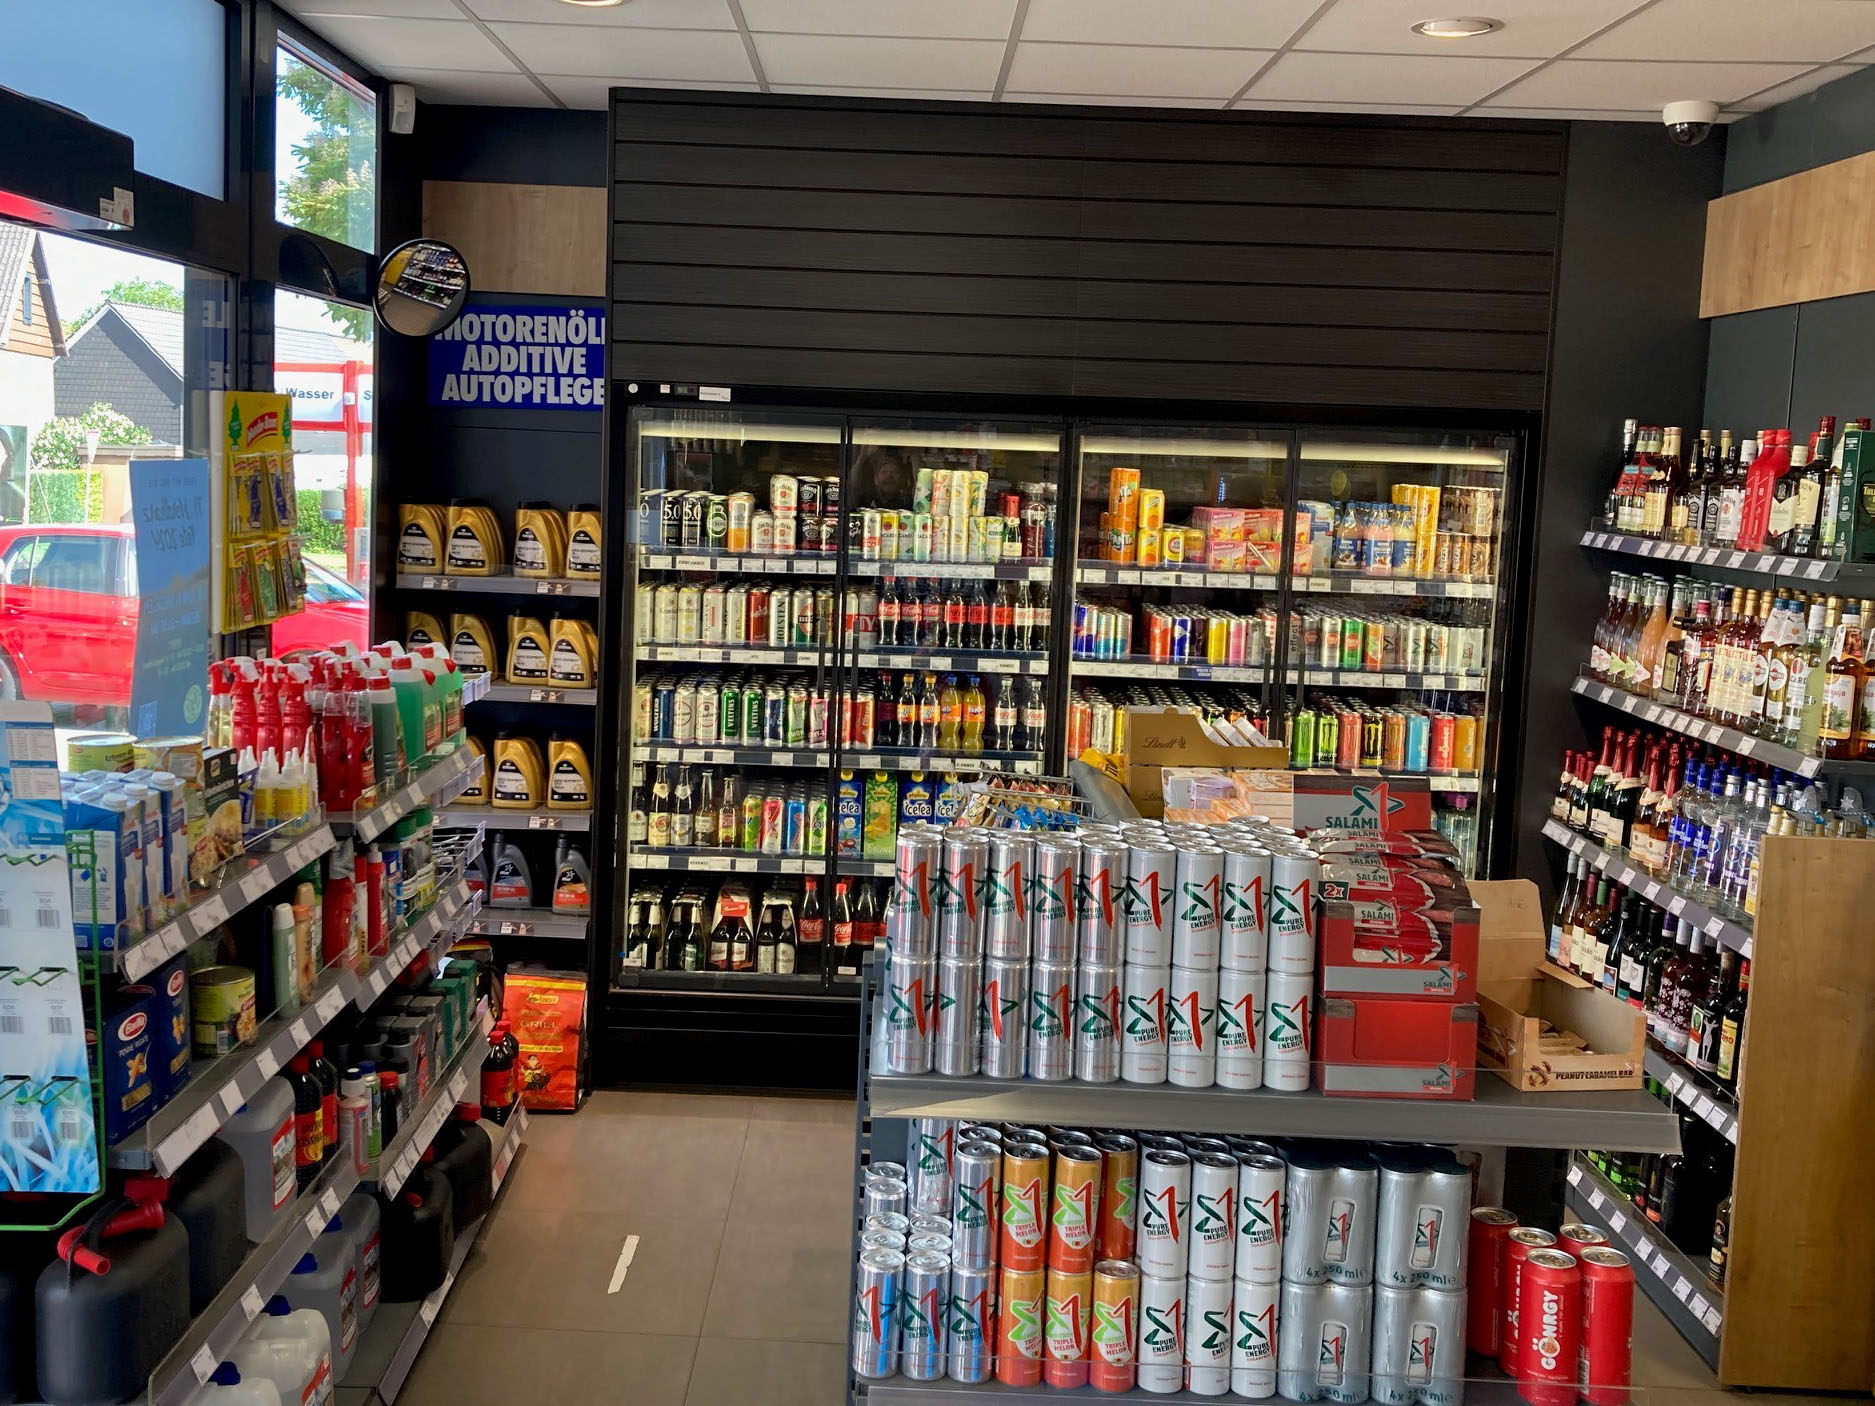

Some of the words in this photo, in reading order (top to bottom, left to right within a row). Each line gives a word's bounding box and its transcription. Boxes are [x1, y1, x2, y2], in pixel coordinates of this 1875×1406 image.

[435, 309, 605, 345] MOTORENÖL
[461, 344, 587, 374] ADDITIVE
[286, 387, 335, 400] Wasser
[441, 373, 605, 405] AUTOPFLEGE
[777, 601, 786, 641] HOLSTEN
[1290, 623, 1299, 652] effect
[727, 699, 735, 728] VELTINS
[750, 699, 759, 729] VELTINS
[1143, 736, 1177, 749] Lindt
[1325, 816, 1378, 830] SALAMI
[1349, 857, 1381, 866] SALAMI
[1356, 873, 1389, 882] SALAMI
[1325, 884, 1343, 898] 2x
[1129, 915, 1153, 923] ENERGY
[1197, 913, 1215, 921] PURE
[1237, 915, 1255, 923] PURE
[1361, 910, 1394, 920] SALAMI
[1190, 919, 1215, 929] ENERGY
[1231, 921, 1256, 930] ENERGY
[1285, 917, 1304, 926] PURE
[1279, 923, 1304, 932] ENERGY
[1423, 981, 1452, 989] SALAMI
[520, 1020, 560, 1029] GRILL
[1141, 1027, 1159, 1035] PURE
[1134, 1033, 1159, 1042] ENERGY
[1170, 1035, 1193, 1043] ENERGY
[1228, 1032, 1246, 1040] PURE
[1285, 1034, 1303, 1042] PURE
[1222, 1038, 1247, 1047] ENERGY
[1278, 1040, 1303, 1049] ENERGY
[1555, 1072, 1584, 1080] PEANUT
[1422, 1079, 1451, 1087] SALAMI
[1015, 1223, 1036, 1231] TRIPLE
[1064, 1225, 1086, 1233] TRIPLE
[1210, 1225, 1227, 1234] PURE
[1016, 1230, 1037, 1238] MELON
[1065, 1231, 1086, 1239] MELON
[1146, 1228, 1170, 1236] ENERGY
[1203, 1231, 1229, 1241] ENERGY
[1256, 1228, 1274, 1236] PURE
[1250, 1233, 1275, 1243] ENERGY
[1306, 1267, 1320, 1278] 4x
[1322, 1265, 1343, 1276] 250
[1393, 1271, 1406, 1284] 4x
[1410, 1271, 1430, 1282] 250
[1432, 1273, 1447, 1285] ml
[1053, 1338, 1074, 1347] TRIPLE
[1105, 1341, 1127, 1350] TRIPLE
[1159, 1337, 1176, 1346] PURE
[1252, 1341, 1270, 1350] PURE
[1054, 1344, 1075, 1352] MELON
[1106, 1347, 1128, 1356] MELON
[1152, 1343, 1177, 1353] ENERGY
[1245, 1348, 1270, 1358] ENERGY
[1389, 1390, 1404, 1401] 4x
[1429, 1391, 1445, 1403] ml
